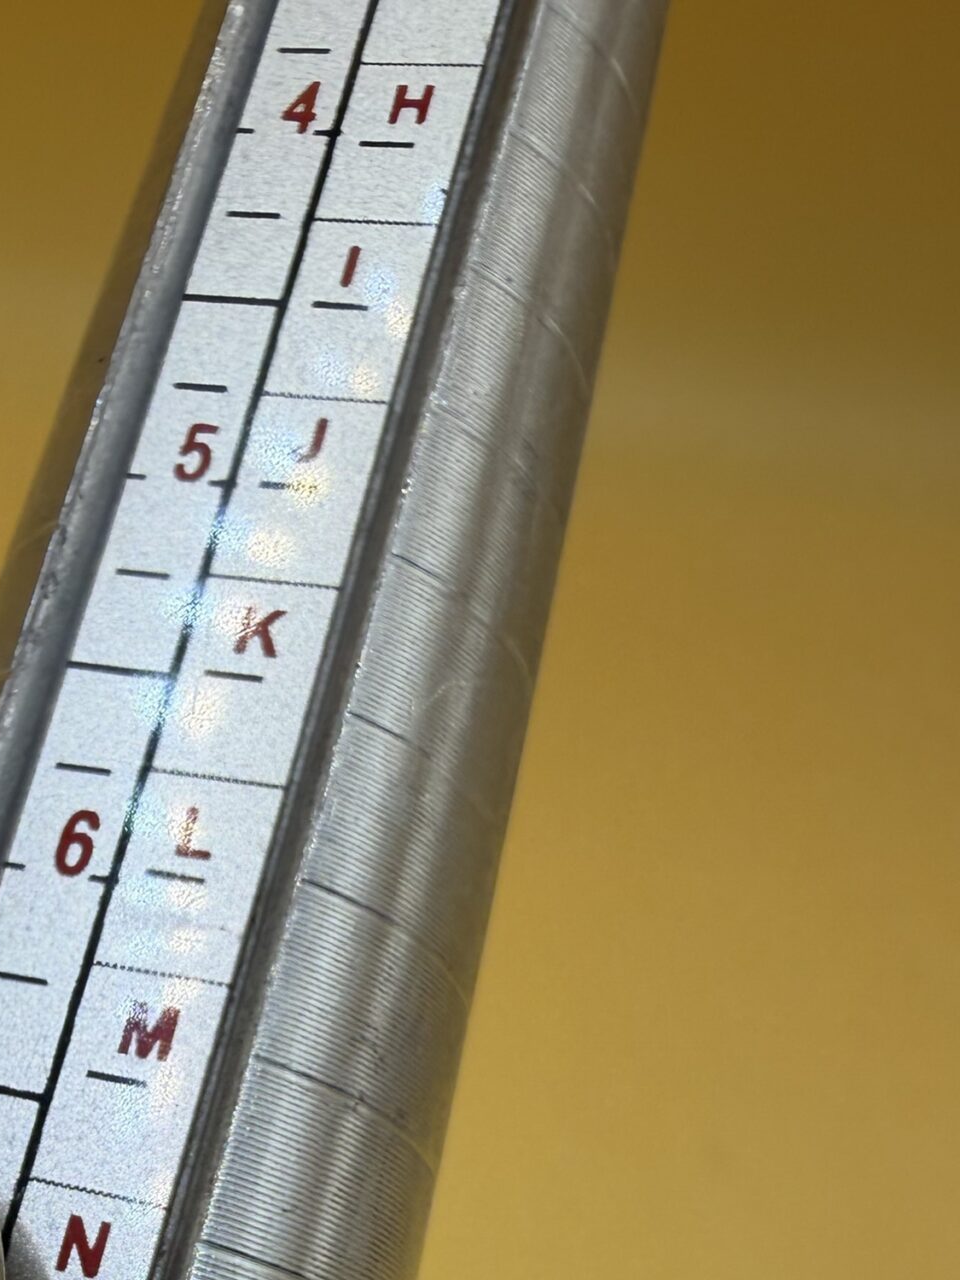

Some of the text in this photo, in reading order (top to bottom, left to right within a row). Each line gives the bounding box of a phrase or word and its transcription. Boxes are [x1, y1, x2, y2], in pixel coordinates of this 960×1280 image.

[281, 81, 321, 133] 4
[388, 84, 436, 125] H
[342, 246, 361, 287] I
[172, 423, 219, 483] 5
[296, 417, 330, 463] J
[233, 606, 287, 659] K
[54, 809, 101, 876] 6
[175, 806, 211, 860] L
[117, 1001, 180, 1062] M
[56, 1214, 111, 1278] N
